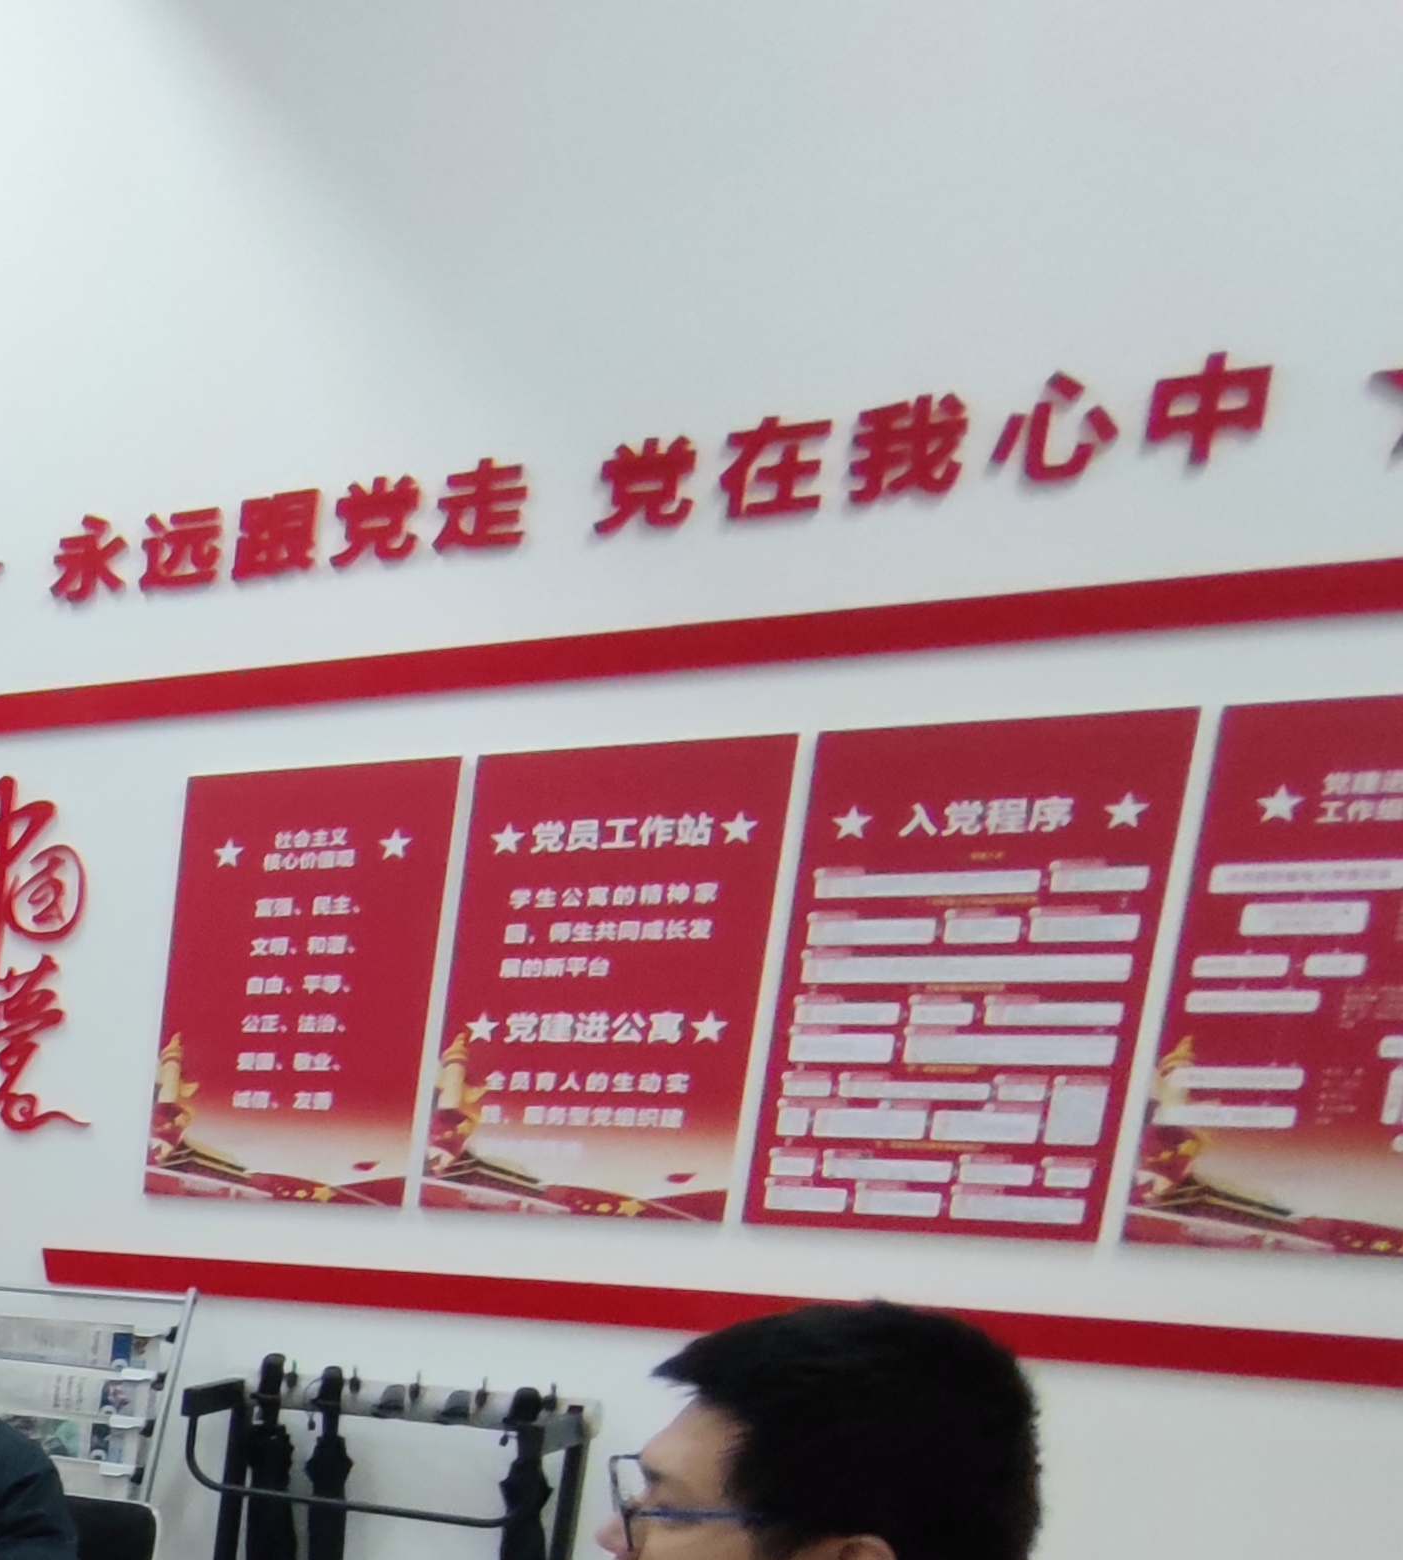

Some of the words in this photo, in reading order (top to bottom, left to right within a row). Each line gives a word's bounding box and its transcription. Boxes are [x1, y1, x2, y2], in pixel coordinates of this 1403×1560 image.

[50, 457, 529, 603] 永远跟党走
[593, 352, 1273, 533] 党在我心中
[530, 811, 715, 854] 党员工作站
[898, 796, 1075, 838] 入党程序
[274, 827, 349, 850] 社会主义
[263, 849, 356, 872] 核心价值观
[508, 882, 719, 910] 学生公寓的精神家
[503, 1011, 686, 1044] 党建进公寓
